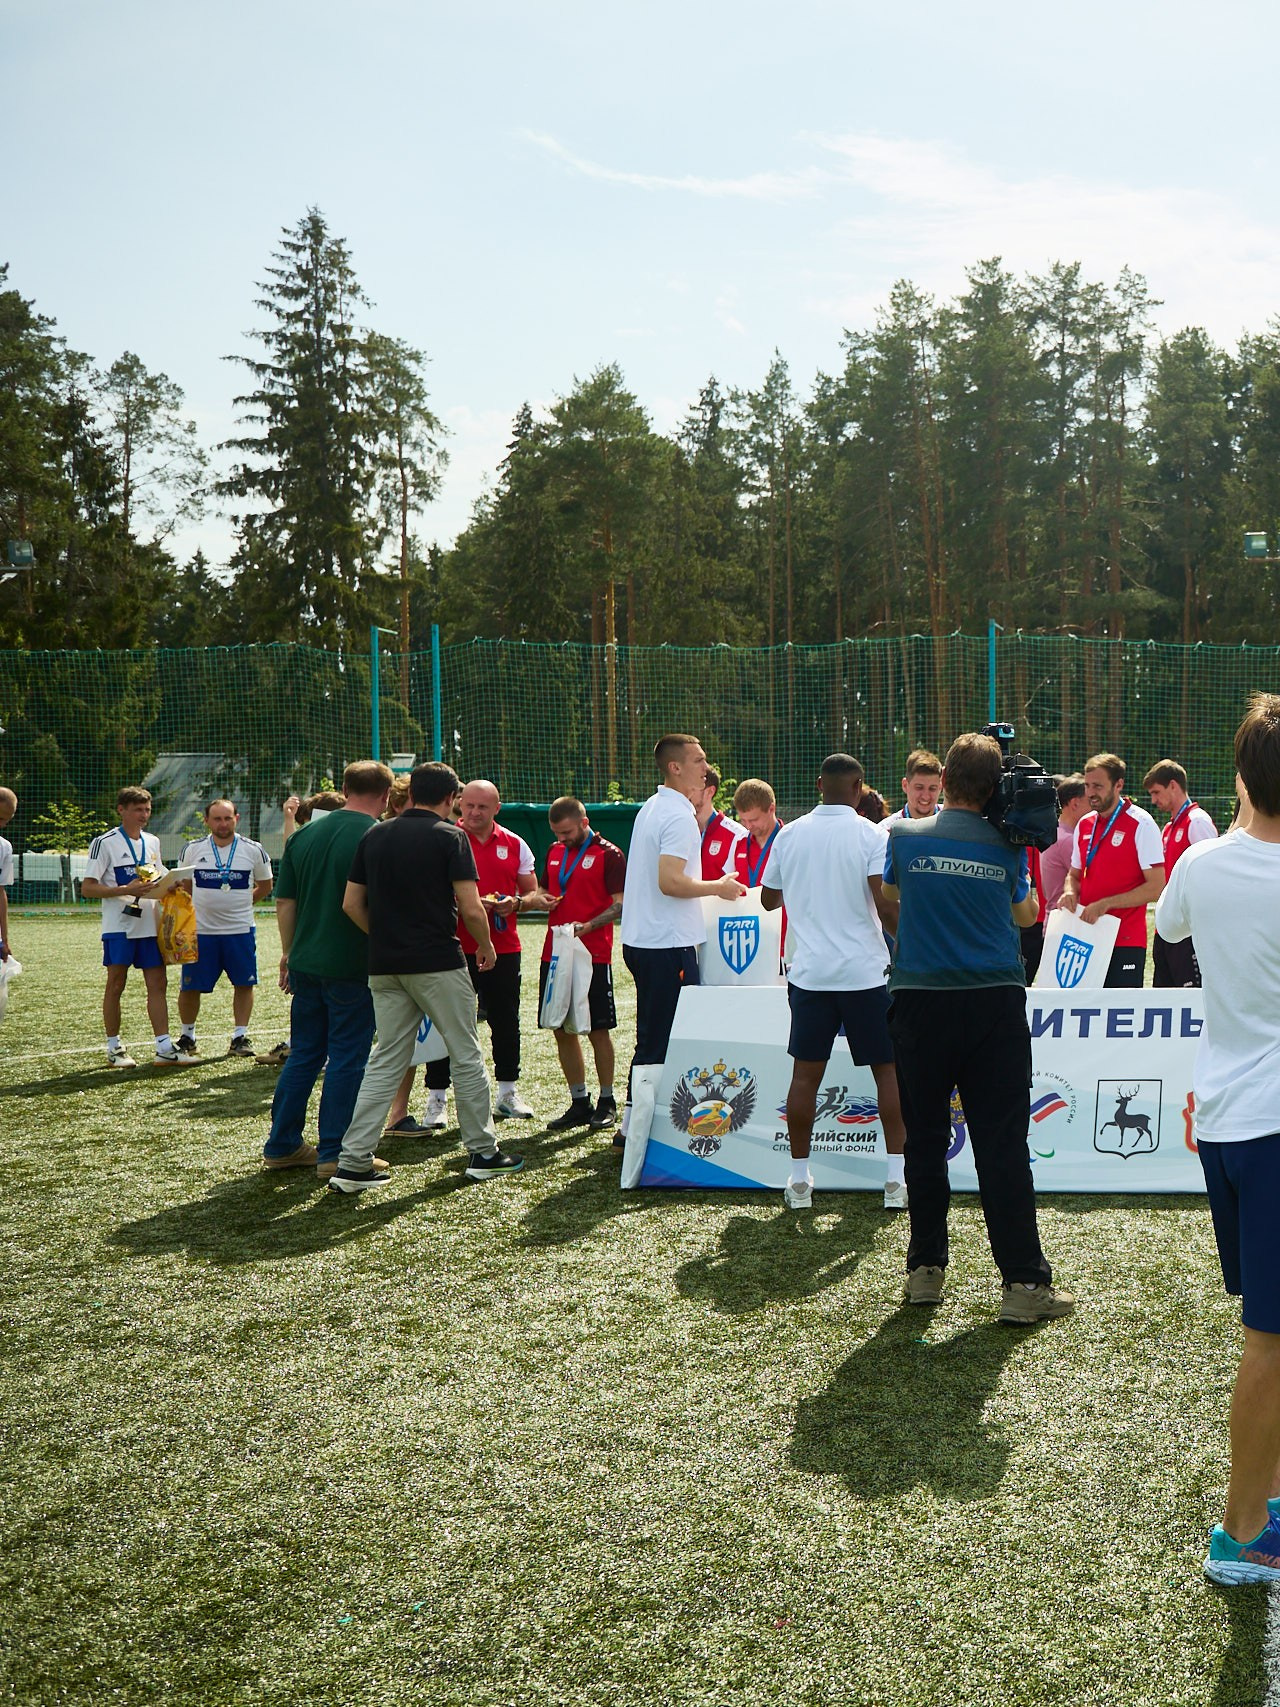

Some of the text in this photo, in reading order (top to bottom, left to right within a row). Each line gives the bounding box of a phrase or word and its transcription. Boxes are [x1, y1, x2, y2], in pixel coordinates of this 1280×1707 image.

[940, 861, 1004, 878] ЛУИДОР
[723, 919, 756, 930] PARI
[1063, 939, 1089, 955] PARI
[1031, 1008, 1204, 1038] ИТЕЛЬ
[774, 1130, 878, 1143] РОИЙСКИЙ
[844, 1144, 875, 1153] ФОНД
[1237, 1547, 1280, 1569] HOKA
